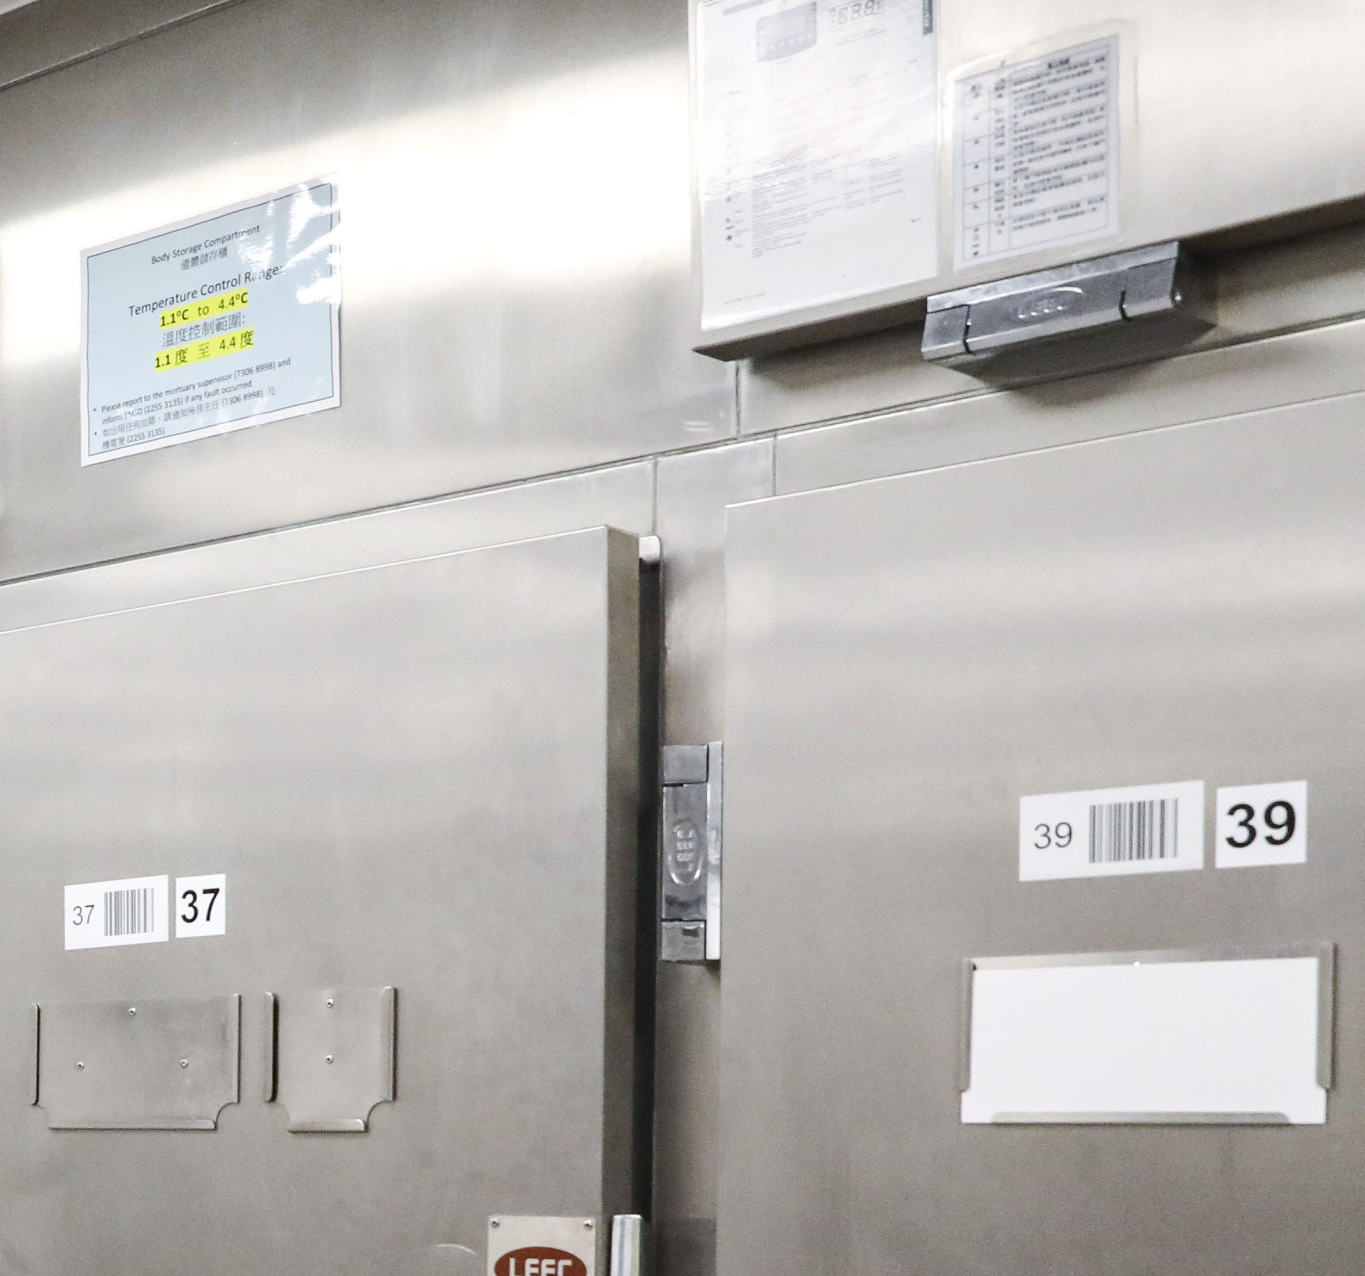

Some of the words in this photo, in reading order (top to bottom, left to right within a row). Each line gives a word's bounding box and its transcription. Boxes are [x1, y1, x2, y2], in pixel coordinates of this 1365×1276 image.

[151, 254, 171, 265] Body
[172, 243, 202, 258] Storage
[204, 225, 260, 248] Compartment
[128, 290, 198, 317] Temperature
[200, 274, 241, 297] Control
[244, 265, 283, 284] Range:
[160, 309, 189, 327] 1.1°C
[198, 306, 209, 317] to
[218, 292, 248, 310] 4.4°C
[155, 354, 172, 368] 1.1
[174, 348, 189, 366] 度
[197, 342, 211, 358] 至
[219, 336, 236, 351] 4.4
[240, 330, 254, 348] 度
[101, 402, 121, 412] Please
[122, 396, 143, 408] report
[144, 394, 151, 402] to
[152, 391, 163, 399] the
[164, 383, 196, 398] mortuary
[197, 373, 232, 388] supervisor
[277, 358, 291, 368] and
[191, 394, 202, 403] any
[204, 388, 220, 398] fault
[221, 380, 252, 394] occurred
[1033, 820, 1074, 851] 39
[1224, 799, 1297, 850] 39
[71, 903, 96, 927] 37
[180, 886, 221, 925] 37
